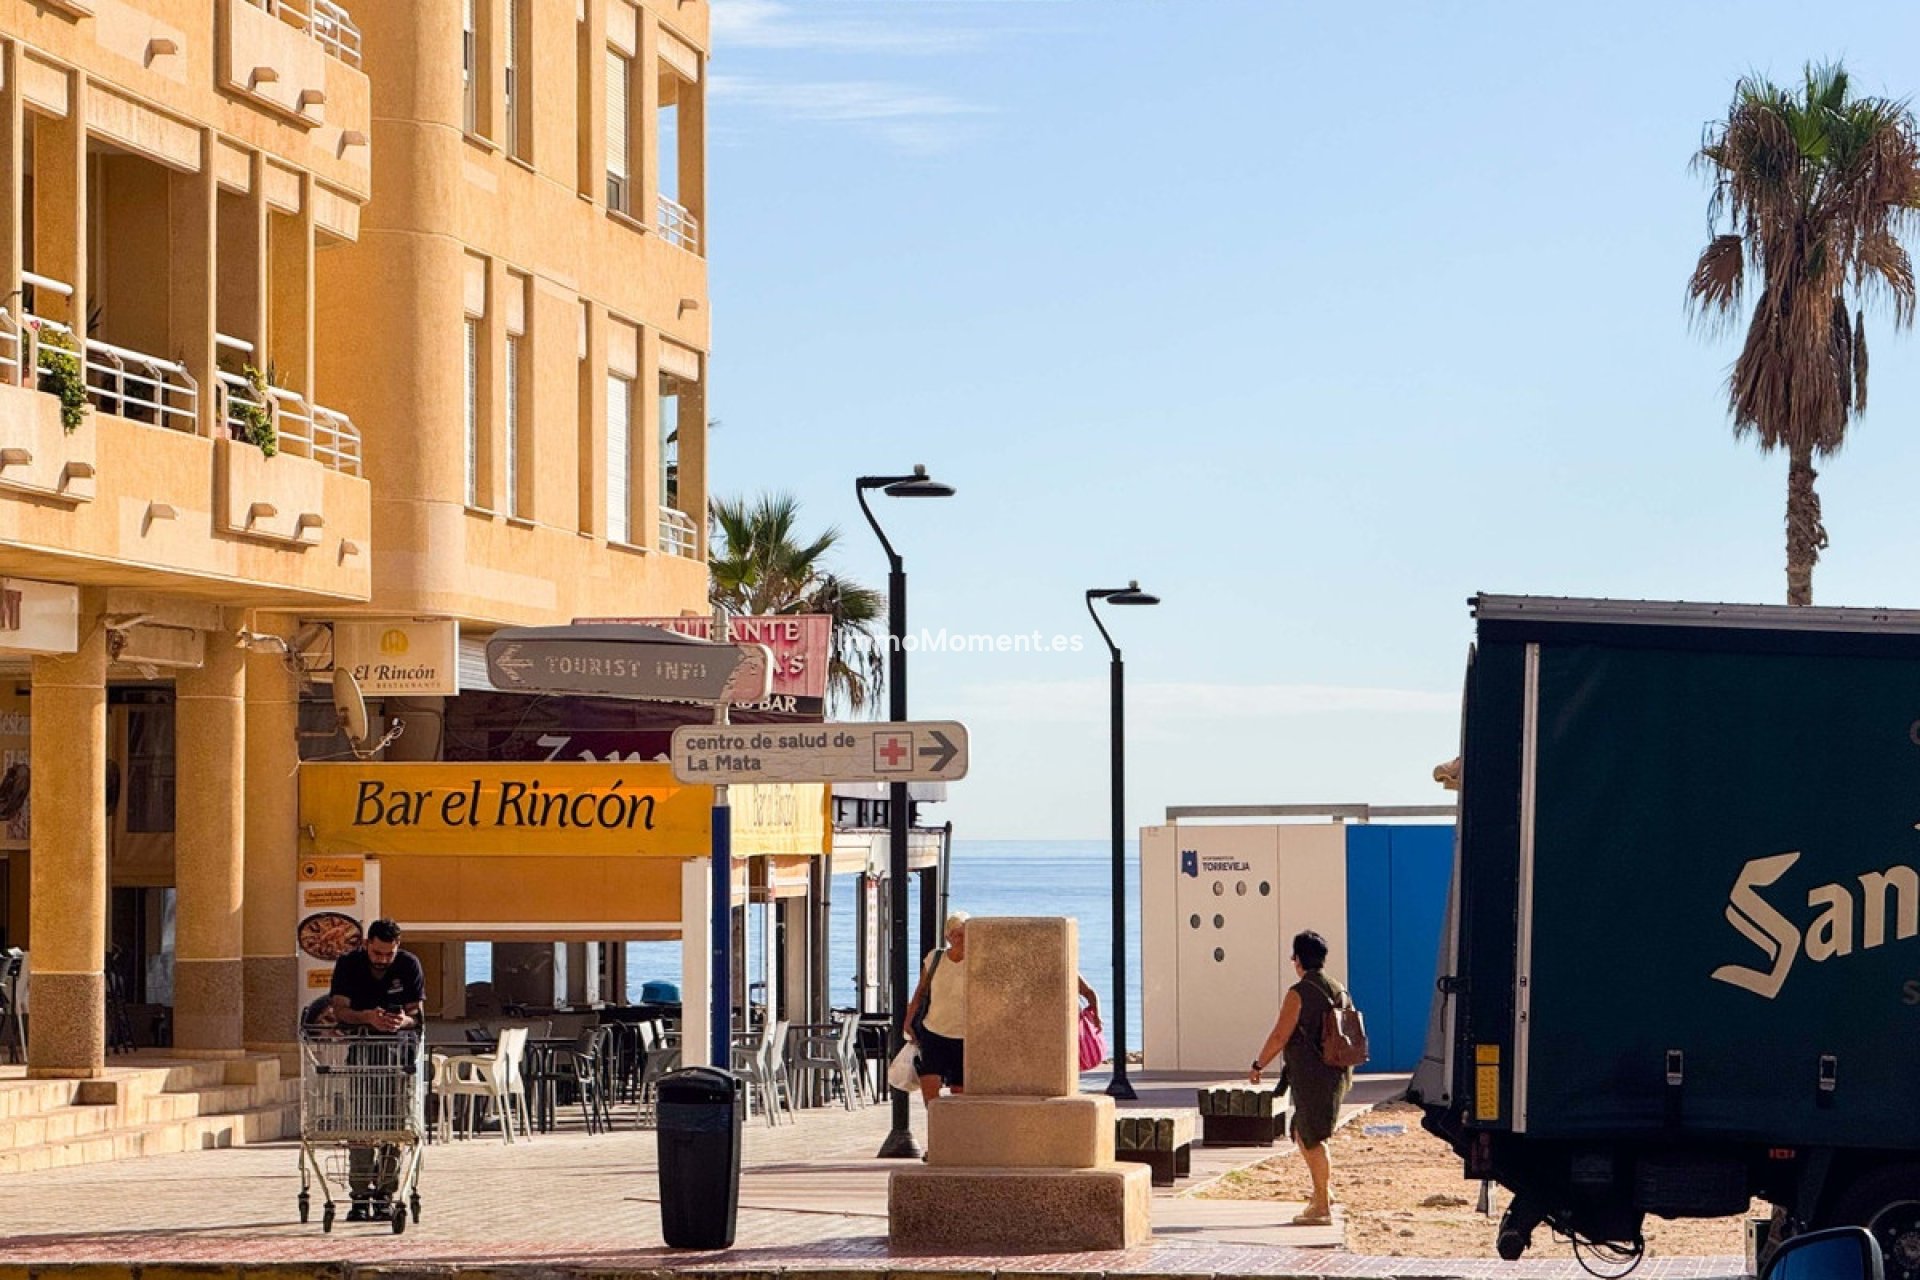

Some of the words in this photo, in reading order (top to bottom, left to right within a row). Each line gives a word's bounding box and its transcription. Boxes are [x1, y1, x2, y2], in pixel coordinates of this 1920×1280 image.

[354, 664, 370, 680] El
[374, 664, 435, 680] Rincón
[545, 656, 641, 678] TOURIST
[686, 735, 745, 750] centro
[751, 733, 772, 748] de
[778, 732, 828, 748] salud
[833, 732, 856, 748] de
[687, 755, 708, 771] La
[716, 755, 761, 771] Mata
[352, 780, 432, 826] Bar
[441, 779, 481, 826] el
[494, 779, 655, 830] Rincón
[1710, 851, 1920, 999] San
